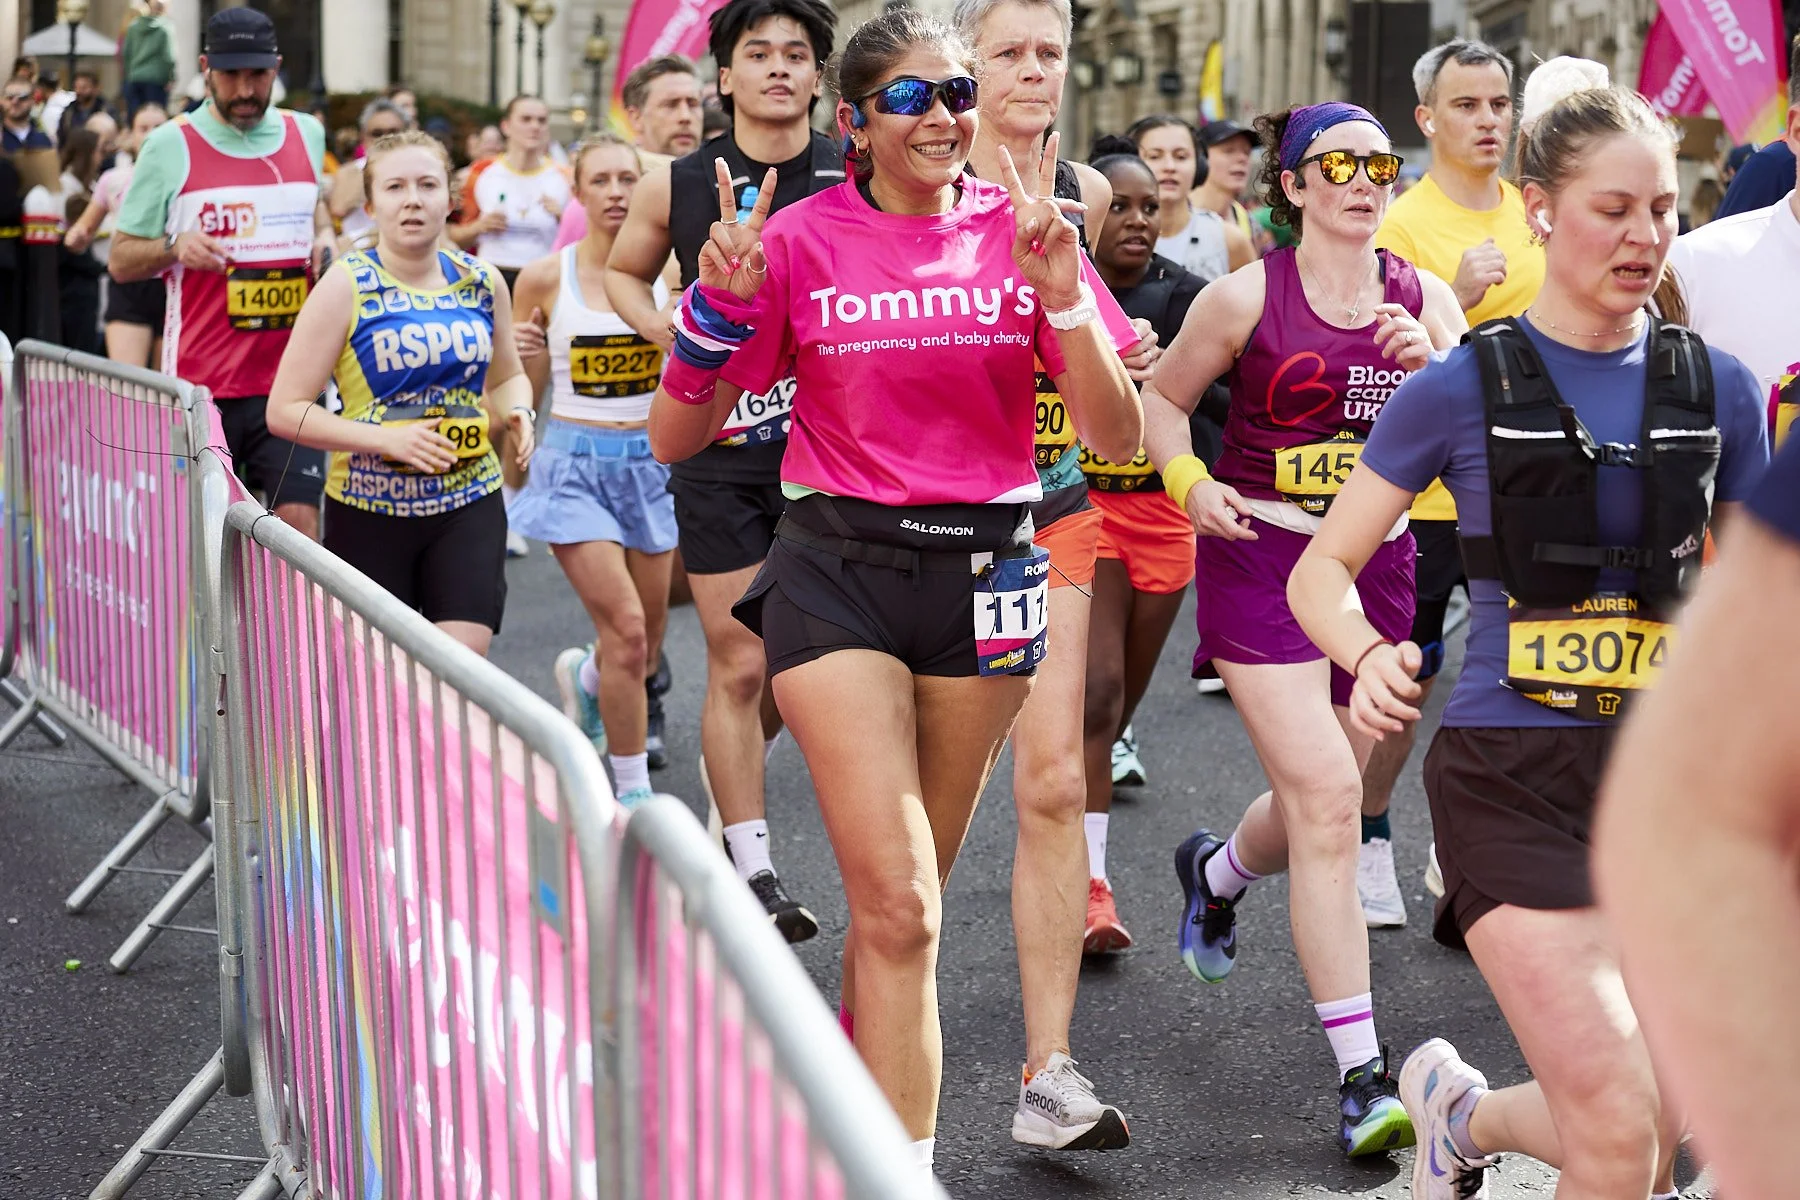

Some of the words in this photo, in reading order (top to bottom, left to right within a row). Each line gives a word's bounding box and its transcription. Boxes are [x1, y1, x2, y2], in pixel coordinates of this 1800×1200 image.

[236, 286, 303, 309] 14001
[809, 276, 1035, 328] Tommy's
[372, 320, 494, 373] RSPCA
[817, 344, 835, 356] The
[838, 336, 917, 356] pregnancy
[921, 332, 950, 347] and
[954, 331, 991, 347] baby
[993, 330, 1031, 347] charity
[577, 350, 659, 376] 13227
[1343, 400, 1382, 422] UK
[899, 518, 974, 536] SALOMON
[986, 589, 1047, 634] 111
[1572, 598, 1638, 613] LAUREN
[1524, 631, 1669, 675] 13074
